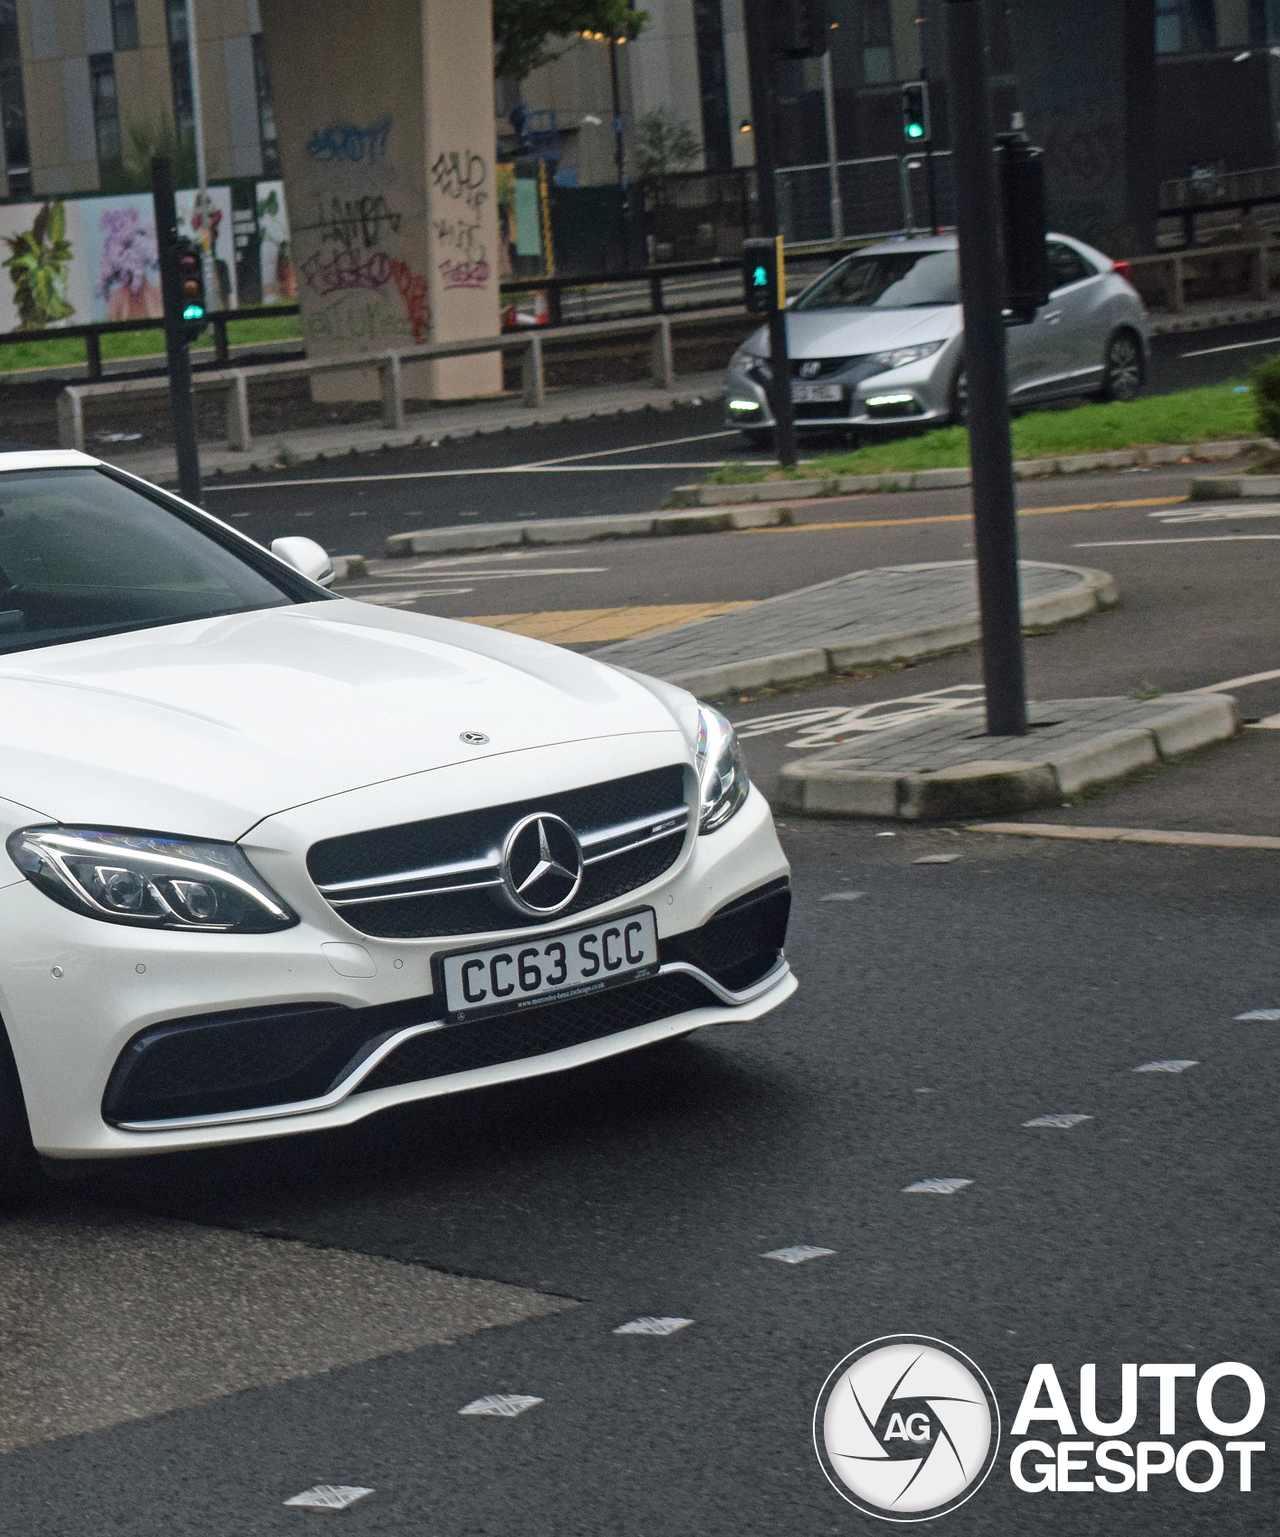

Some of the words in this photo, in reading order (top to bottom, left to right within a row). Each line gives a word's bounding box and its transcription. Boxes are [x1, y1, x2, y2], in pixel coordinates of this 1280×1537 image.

[461, 941, 568, 1004] CC63
[578, 921, 644, 978] SCC
[517, 981, 605, 1008] www.mercedes-benz.inchcape.co.uk
